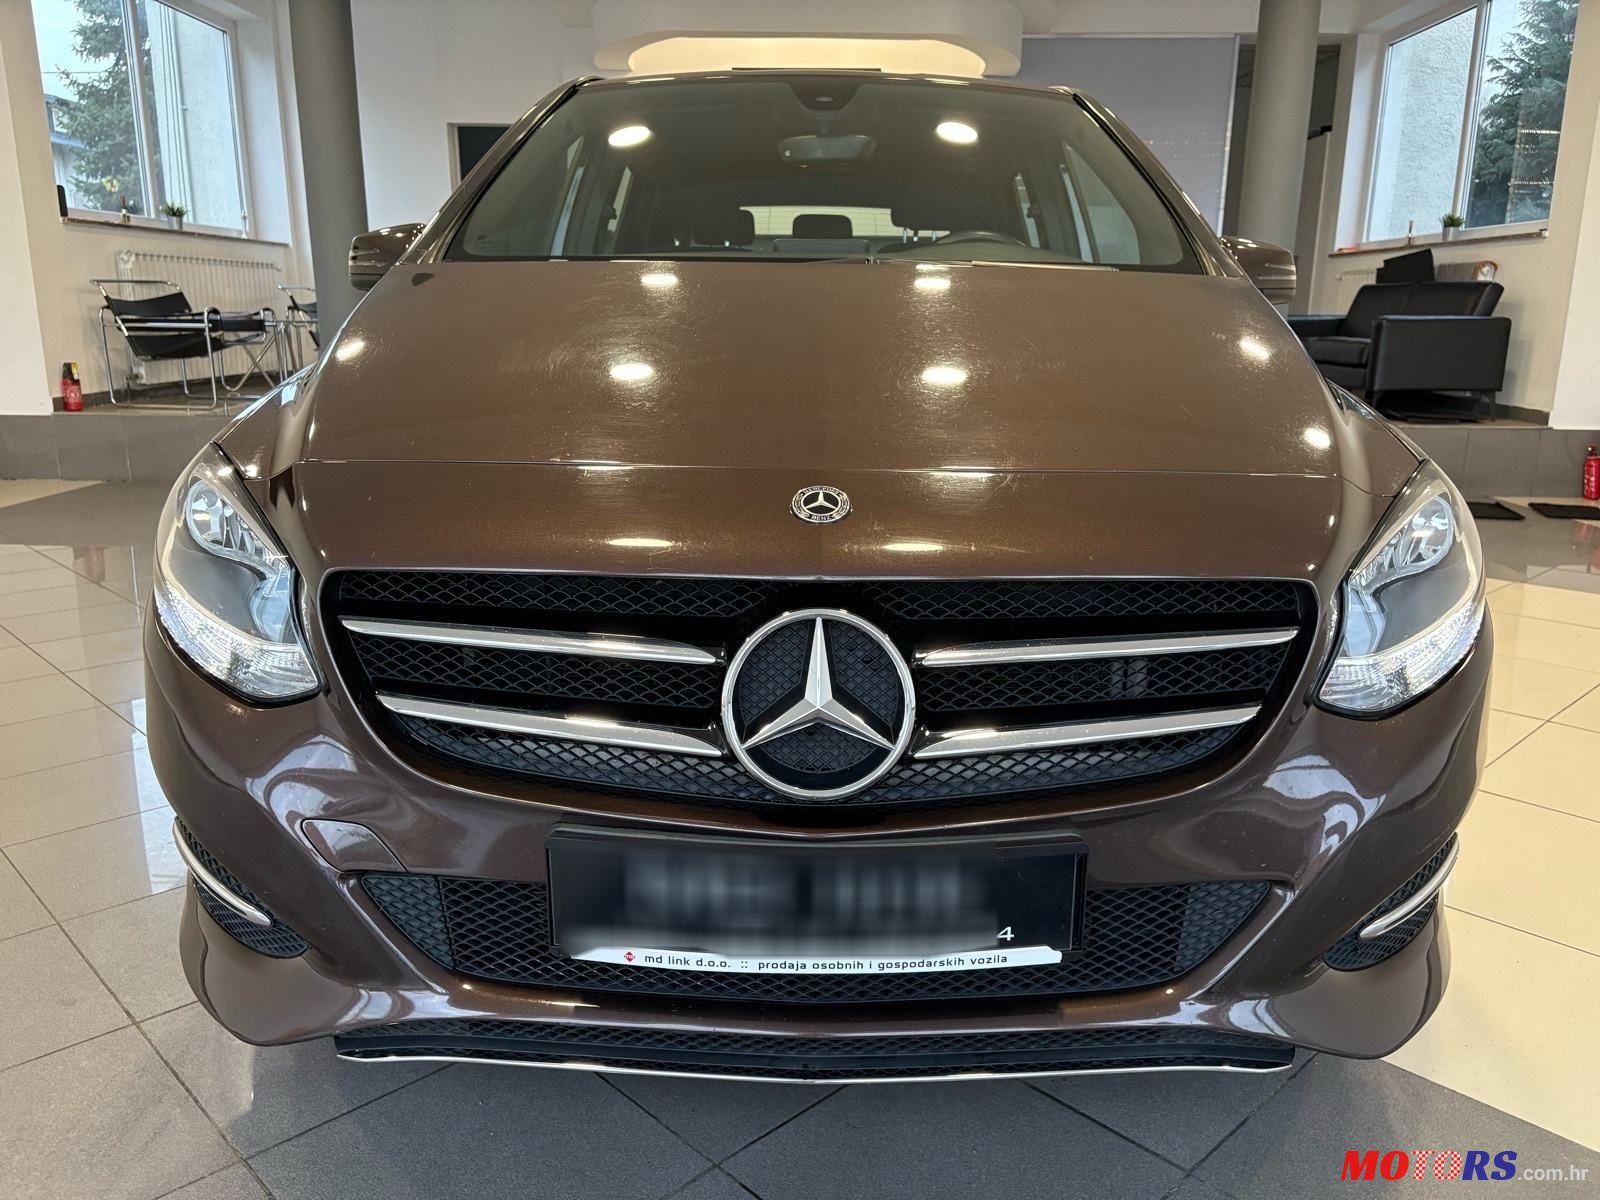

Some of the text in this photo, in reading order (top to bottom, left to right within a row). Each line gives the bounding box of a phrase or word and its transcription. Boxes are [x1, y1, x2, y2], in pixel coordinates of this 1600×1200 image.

[996, 926, 1015, 941] 4
[645, 953, 663, 964] md
[668, 954, 690, 966] link
[696, 955, 731, 968] d.o.o.
[758, 960, 807, 971] prodaja
[812, 960, 864, 970] osobnih
[878, 957, 965, 971] gospodarskih
[970, 955, 1008, 965] vozila
